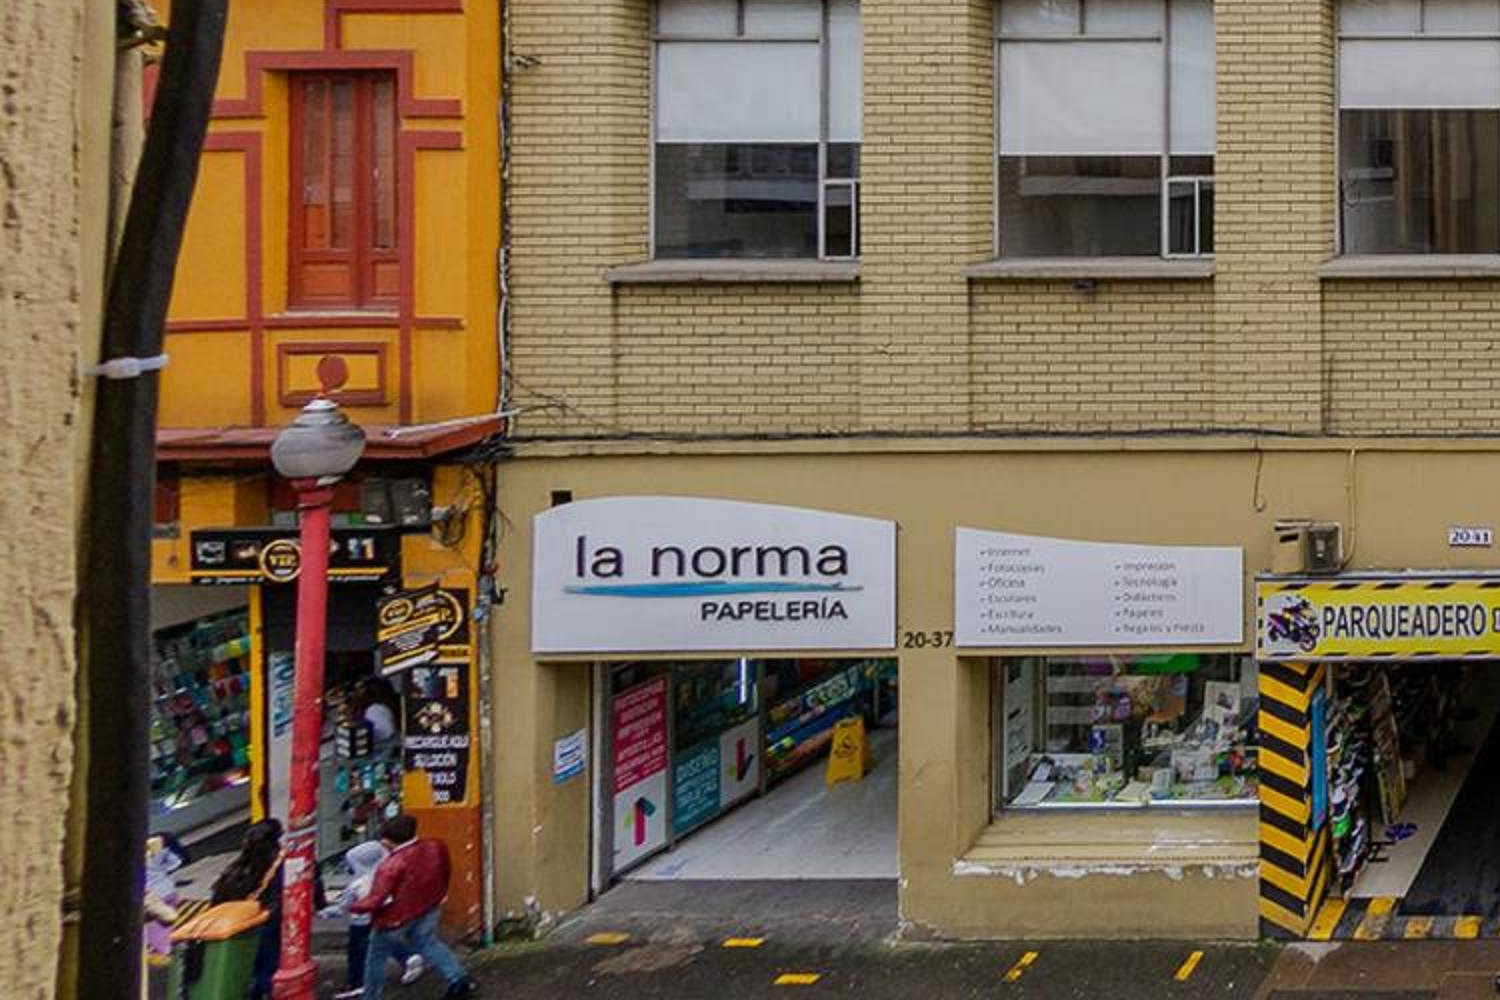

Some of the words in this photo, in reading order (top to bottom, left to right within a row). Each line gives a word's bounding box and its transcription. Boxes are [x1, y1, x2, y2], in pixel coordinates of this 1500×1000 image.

[576, 535, 624, 578] la
[651, 544, 849, 578] norma
[700, 597, 849, 621] PAPELERÍA
[1322, 604, 1487, 638] PARQUEADERO
[903, 631, 954, 649] 20-37
